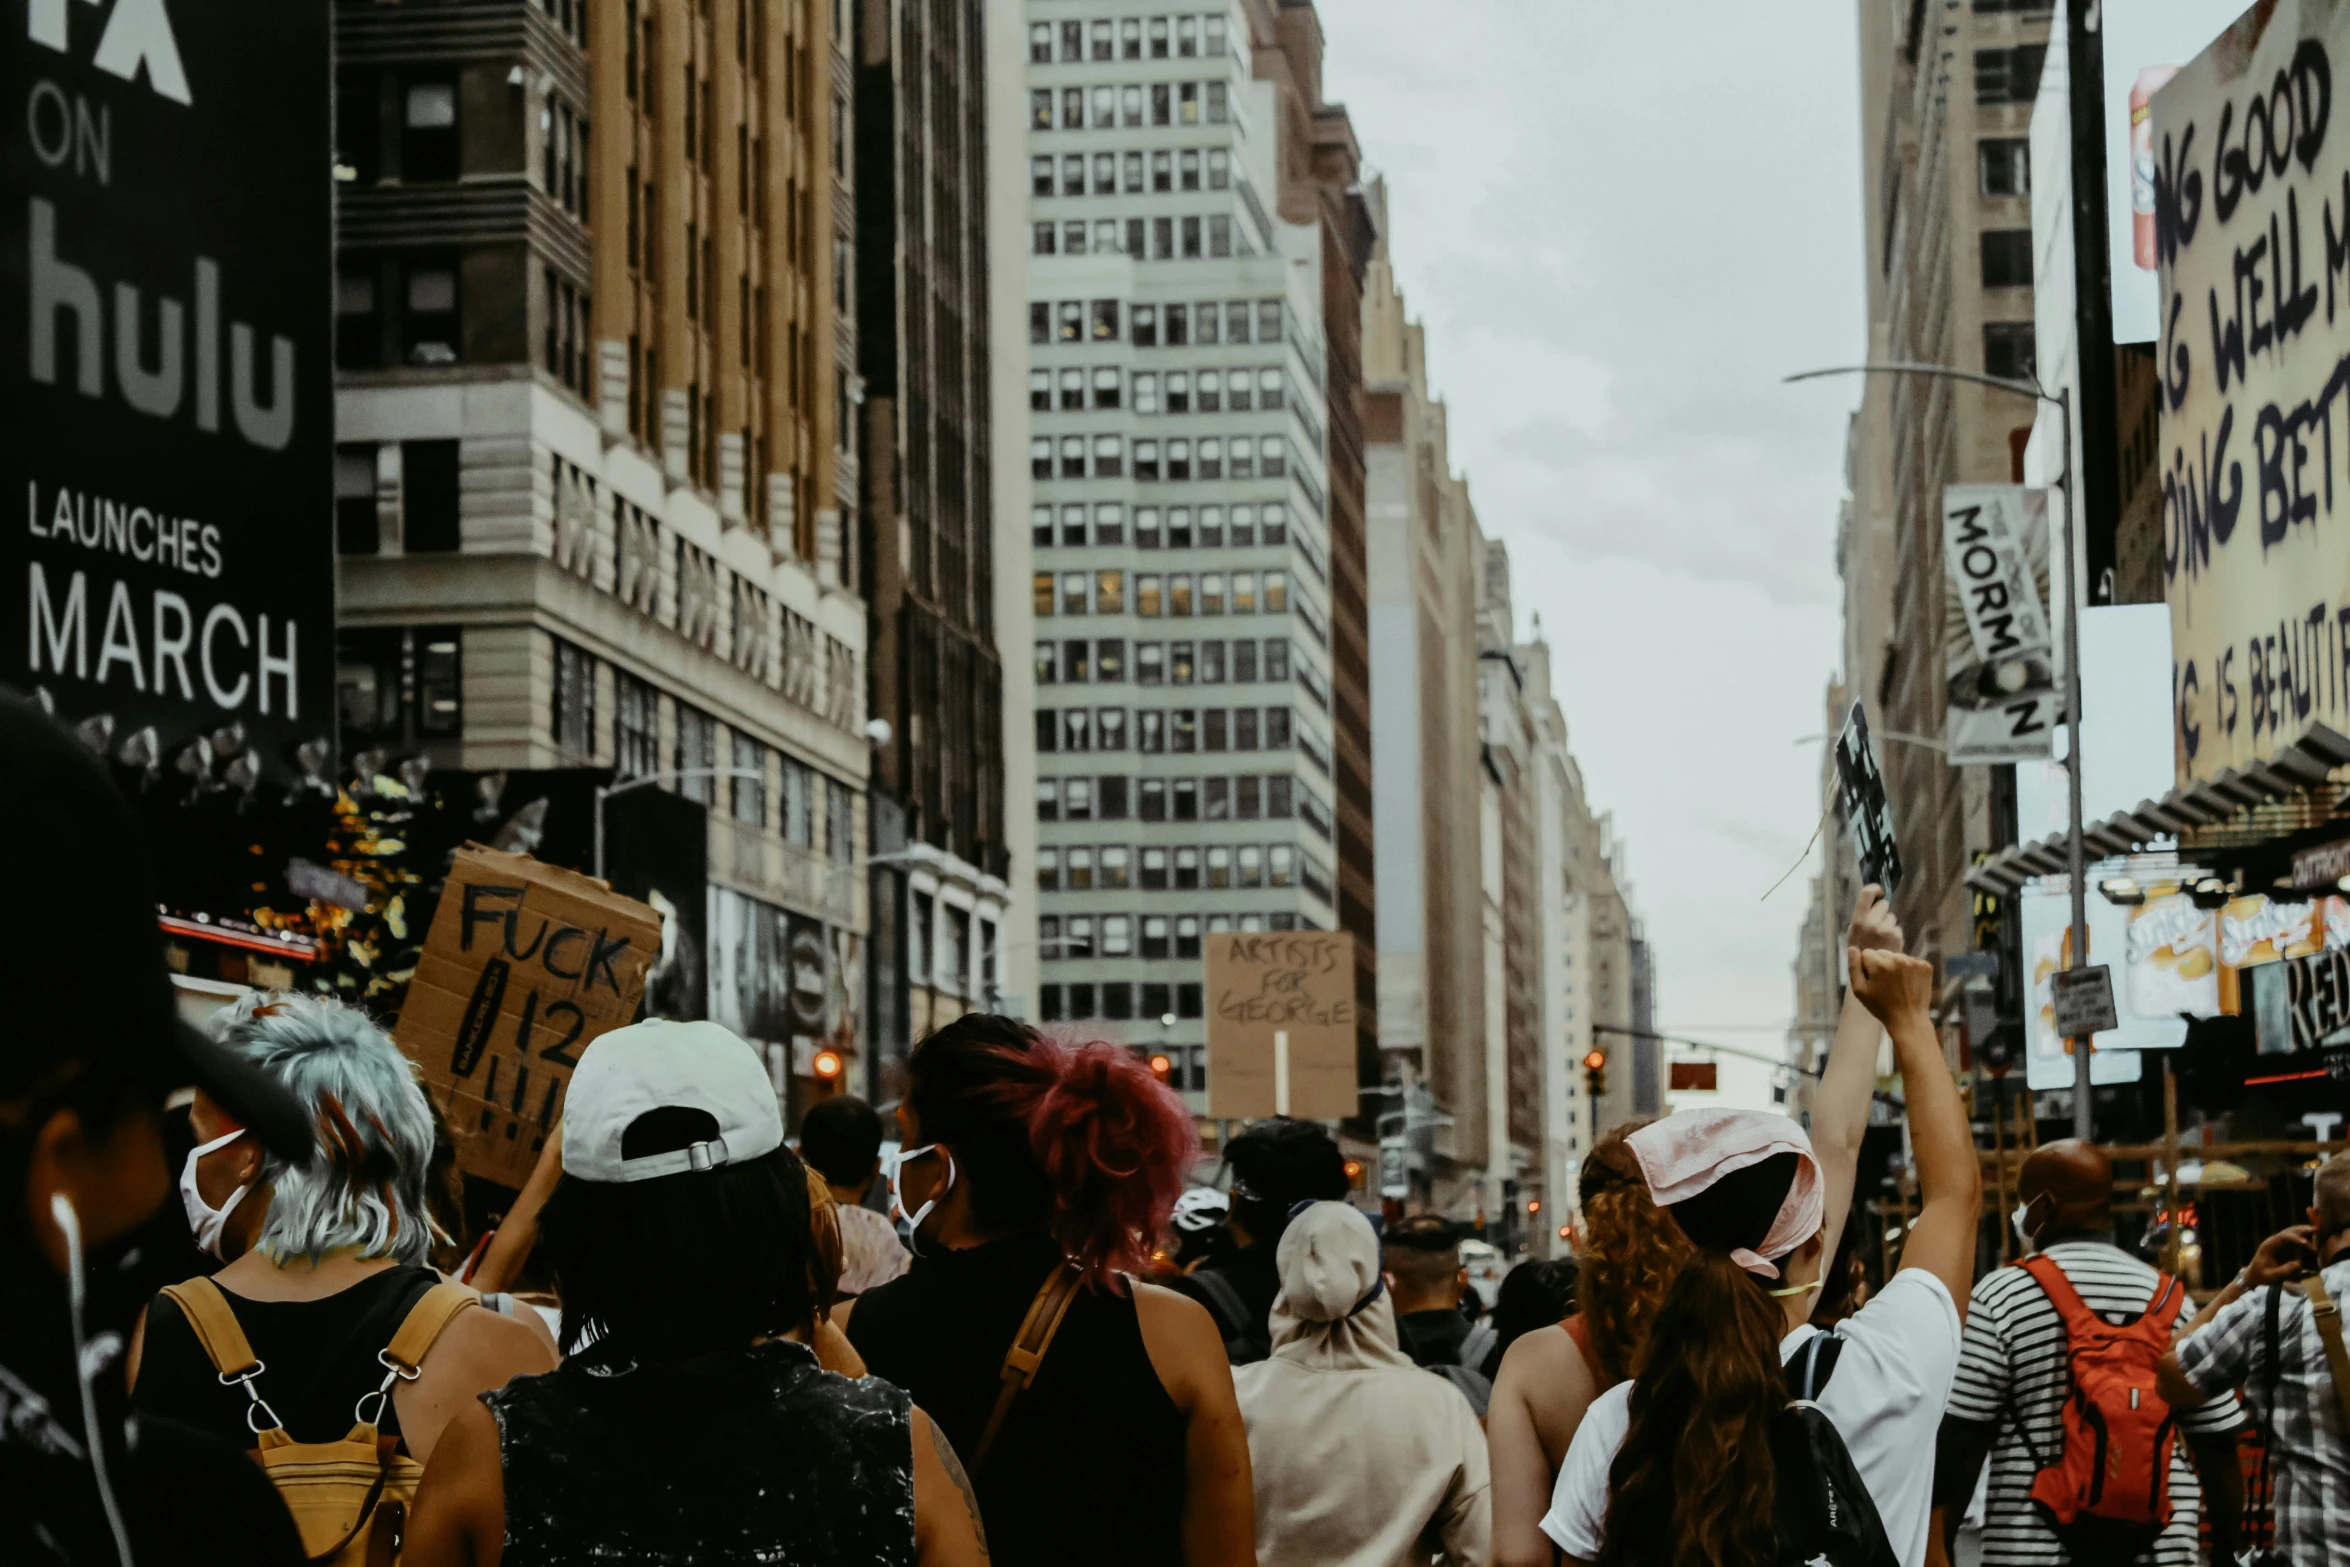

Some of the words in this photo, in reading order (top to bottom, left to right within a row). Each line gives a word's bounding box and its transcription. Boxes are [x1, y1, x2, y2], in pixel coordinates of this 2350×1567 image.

[27, 80, 110, 187] ON
[2213, 38, 2332, 224] GOOD
[28, 195, 295, 451] hulu
[2209, 185, 2319, 395] WELL
[28, 480, 223, 579] LAUNCHES
[28, 560, 298, 722] MARCH
[2215, 645, 2238, 738] IS
[460, 882, 631, 999] FUCK
[1228, 938, 1339, 974] ARTISTS
[1261, 968, 1312, 999] FOR
[515, 987, 586, 1069] 12
[1217, 990, 1352, 1026] GEORGE
